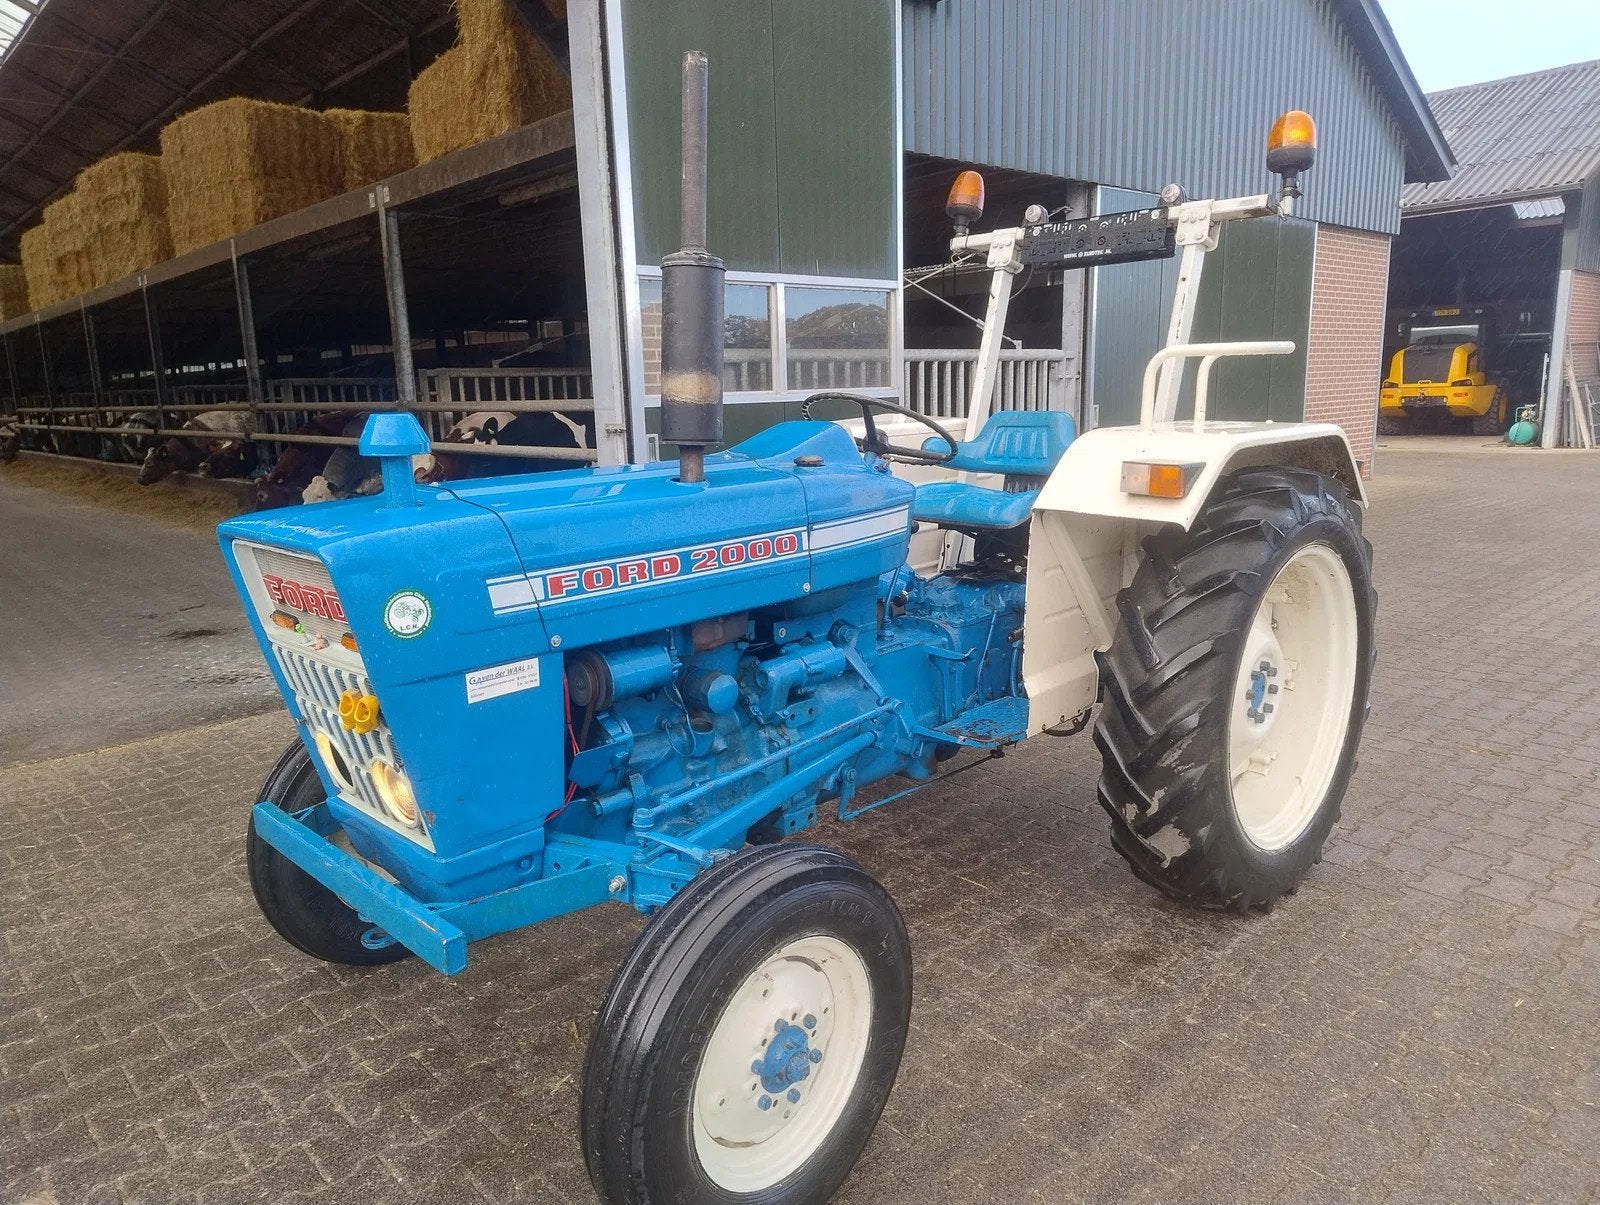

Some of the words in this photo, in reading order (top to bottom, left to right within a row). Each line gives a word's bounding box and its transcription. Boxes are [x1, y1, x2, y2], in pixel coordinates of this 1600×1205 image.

[546, 555, 681, 599] FORD
[691, 533, 798, 572] 2000
[263, 574, 349, 624] FORD
